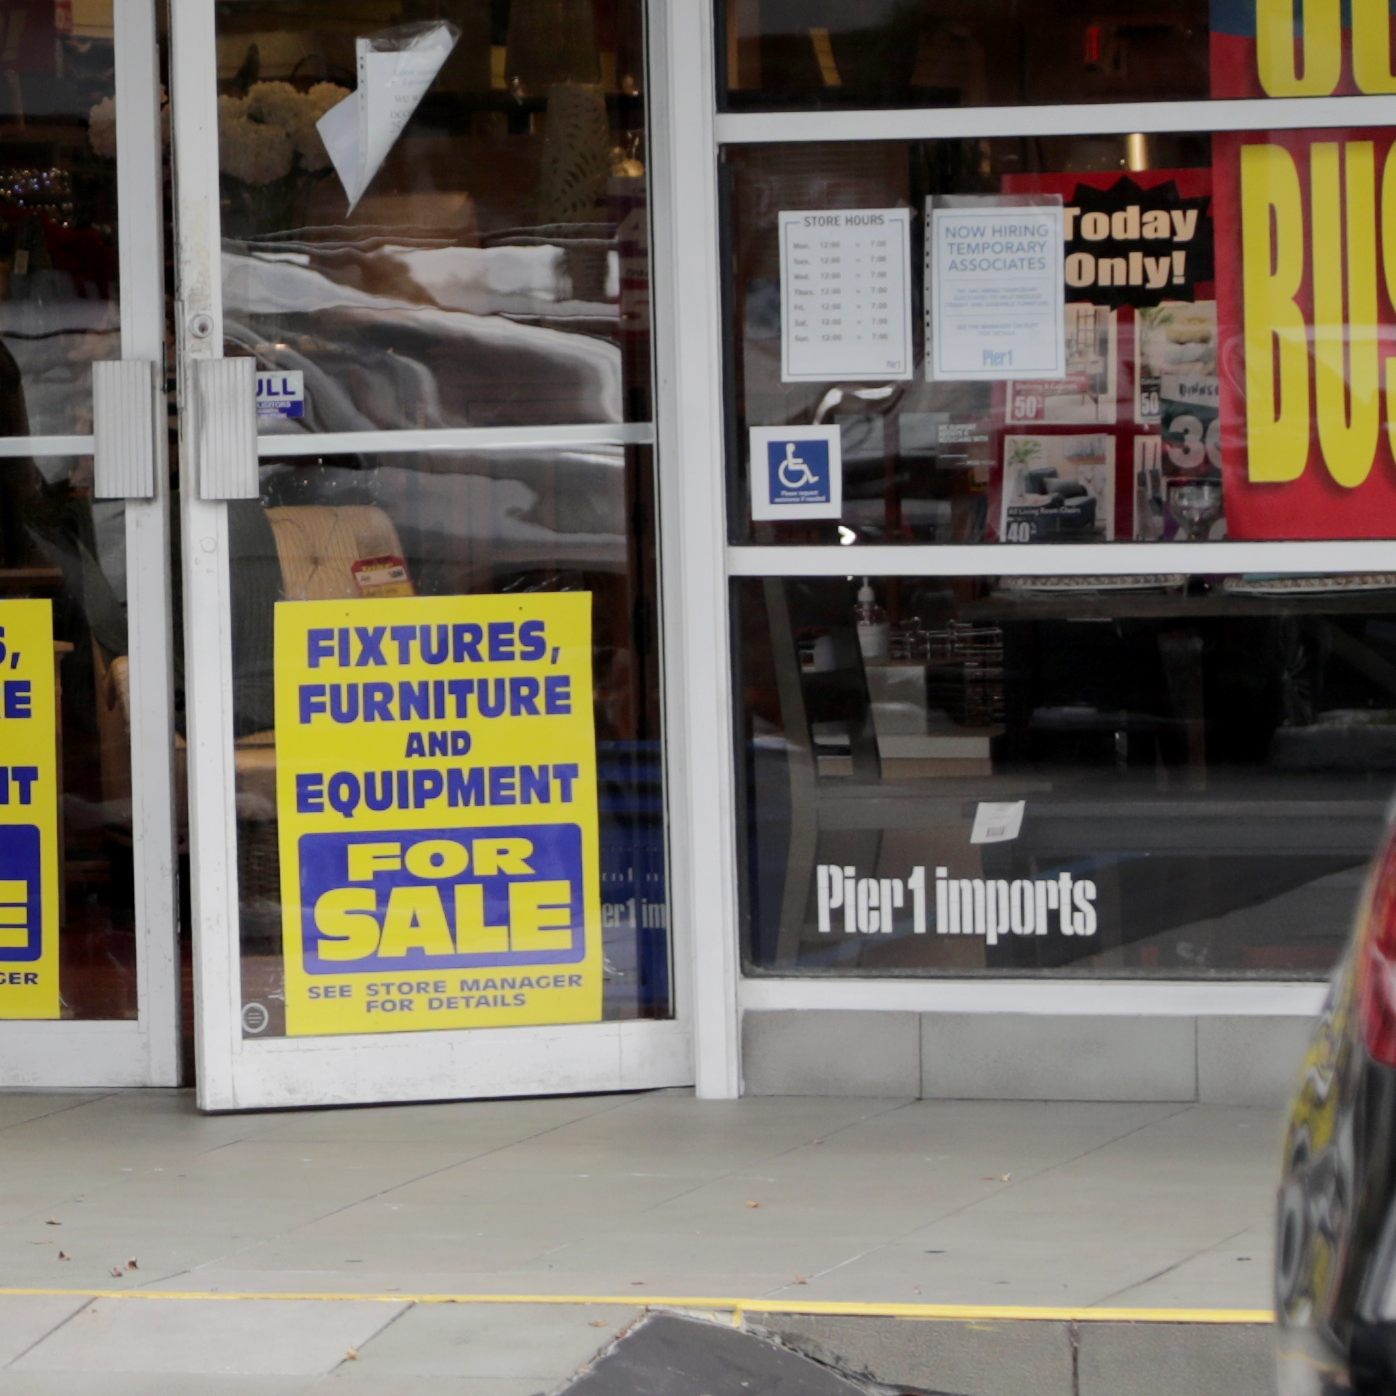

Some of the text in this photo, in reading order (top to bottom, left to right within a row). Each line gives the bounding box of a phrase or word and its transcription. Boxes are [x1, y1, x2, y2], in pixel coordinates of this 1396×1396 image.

[804, 214, 885, 227] STORE HOURS
[945, 224, 1049, 239] NOW HIRING
[1062, 206, 1198, 246] Today
[947, 240, 1048, 255] TEMPORARY
[948, 256, 1047, 272] ASSOCIATES
[1064, 251, 1187, 289] Only!
[982, 350, 1005, 367] Pier
[307, 620, 561, 669] FIXTURES,
[298, 674, 572, 724] FURNITURE
[405, 730, 472, 758] AND
[296, 763, 579, 818] EQUIPMENT
[347, 837, 536, 882] FOR
[313, 880, 573, 961] SALE
[817, 864, 904, 933] Pier
[936, 866, 1098, 945] imports
[308, 974, 583, 1000] SEE STORE MANAGER
[366, 993, 527, 1013] FOR DETAILS
